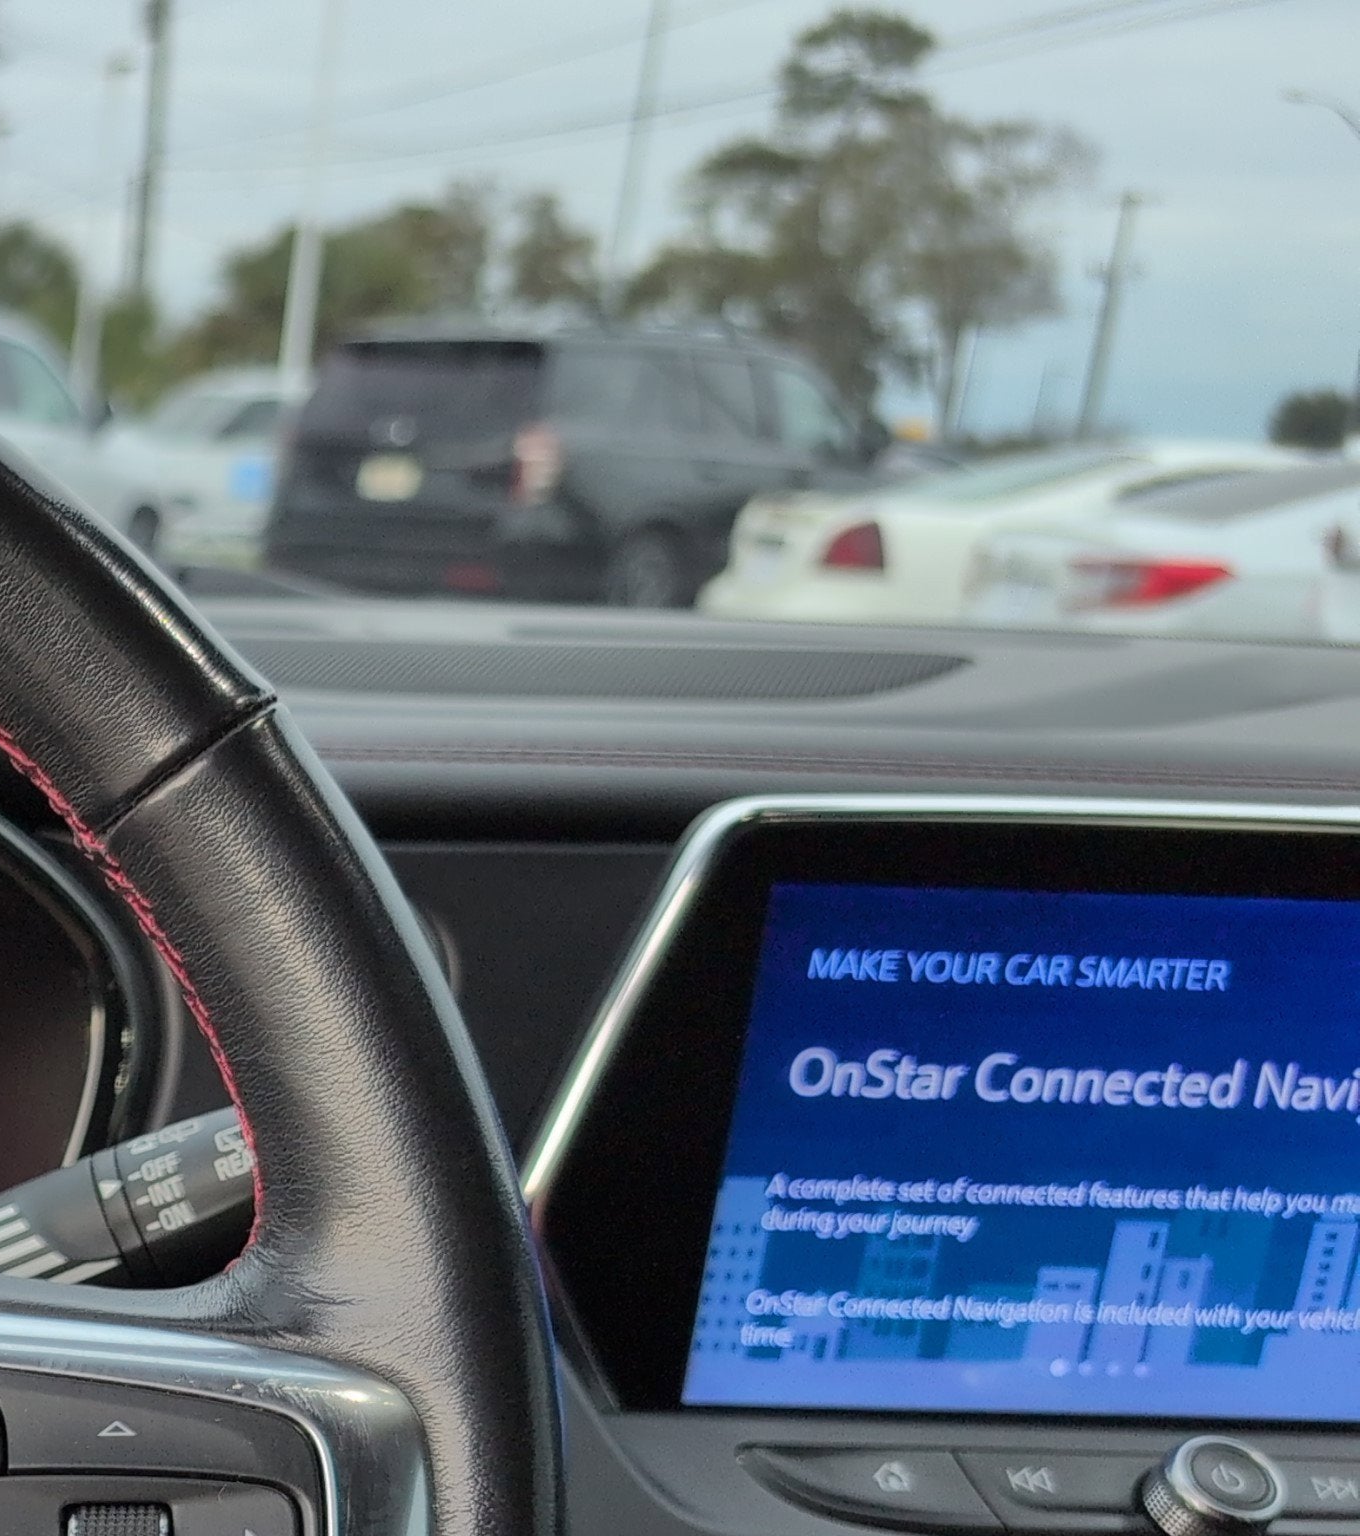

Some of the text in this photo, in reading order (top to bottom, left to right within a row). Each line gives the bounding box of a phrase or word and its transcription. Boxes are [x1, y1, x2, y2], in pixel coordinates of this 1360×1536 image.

[807, 948, 1232, 992] MAKE YOUR CAR SMARTER
[788, 1046, 1360, 1112] OnStar Connected Navi
[140, 1151, 182, 1181] OFF
[147, 1174, 185, 1207] INT
[765, 1172, 788, 1199] A
[788, 1173, 897, 1206] complete
[897, 1178, 935, 1203] set
[936, 1176, 971, 1204] of
[966, 1178, 1090, 1207] connected
[1090, 1180, 1183, 1210] features
[1185, 1183, 1232, 1212] that
[1232, 1184, 1283, 1218] help
[1282, 1193, 1327, 1219] you
[158, 1200, 197, 1231] ON
[761, 1204, 980, 1242] during your journey
[745, 1289, 828, 1317] OnStar
[829, 1291, 953, 1320] Connected
[952, 1294, 1070, 1328] Navigation
[1073, 1300, 1094, 1324] is
[1096, 1300, 1189, 1326] included
[1194, 1302, 1243, 1329] with
[1240, 1308, 1293, 1335] your
[740, 1323, 793, 1348] time
